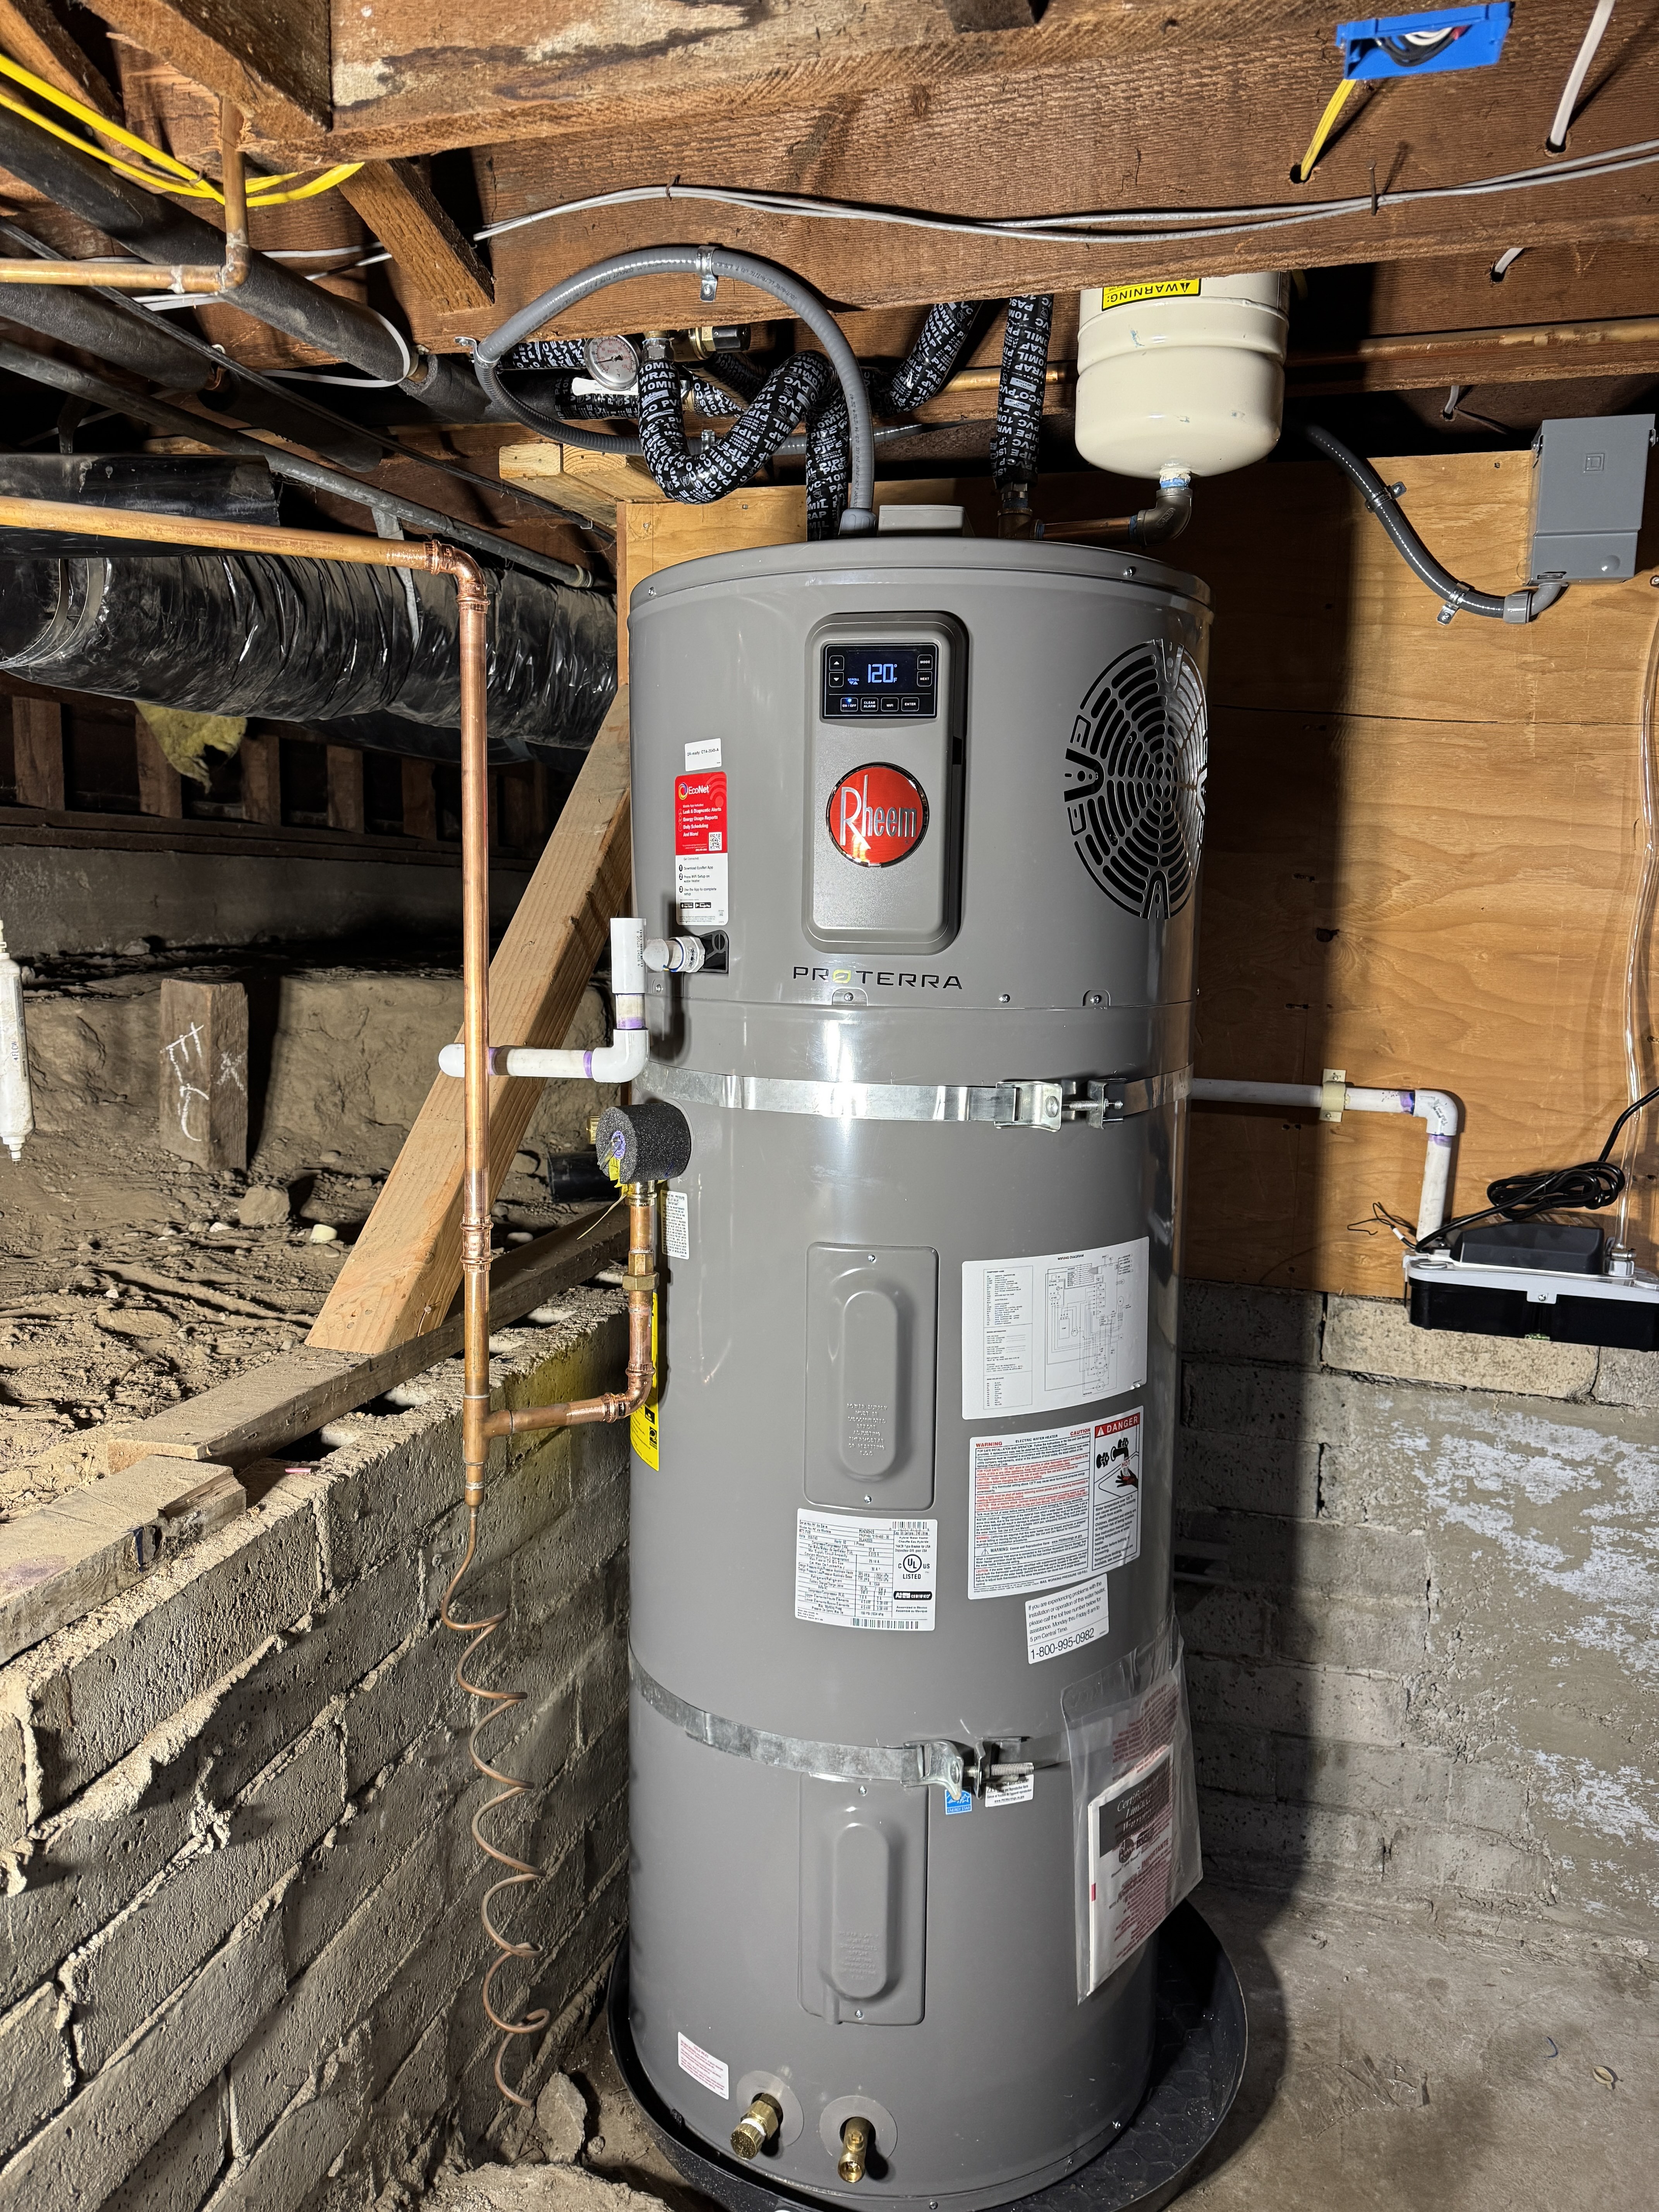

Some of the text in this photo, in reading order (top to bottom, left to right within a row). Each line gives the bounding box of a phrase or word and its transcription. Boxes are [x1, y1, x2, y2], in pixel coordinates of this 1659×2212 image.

[1107, 282, 1179, 303] WARNING:
[924, 321, 937, 347] RAP
[931, 357, 947, 372] PIP
[640, 372, 675, 385] WRAP
[641, 381, 677, 393] 10MIL
[784, 376, 809, 394] PVC
[694, 383, 714, 417] PASCO
[704, 383, 720, 416] 10MIL
[778, 395, 802, 414] PVC
[811, 425, 838, 440] PIPE
[1017, 419, 1039, 432] PVC
[732, 426, 761, 443] PIPE
[1015, 429, 1039, 443] PIPE
[721, 441, 750, 464] PIPE
[1012, 438, 1036, 452] PVC
[709, 448, 738, 477] 10MIL
[1010, 448, 1037, 462] PIPE
[699, 453, 732, 486] PASCO
[686, 462, 716, 499] PASCO
[807, 511, 827, 520] RAP
[840, 774, 917, 849] Rheem
[793, 966, 962, 989] PROTERRA
[1107, 1416, 1137, 1433] DANGER
[908, 1558, 917, 1569] UL
[1048, 1594, 1072, 1605] experiencing
[1073, 1588, 1089, 1598] problems
[1029, 1609, 1049, 1618] installation
[1055, 1601, 1073, 1611] operation
[1072, 1604, 1085, 1613] number
[1031, 1628, 1094, 1659] 1-800-995-0982
